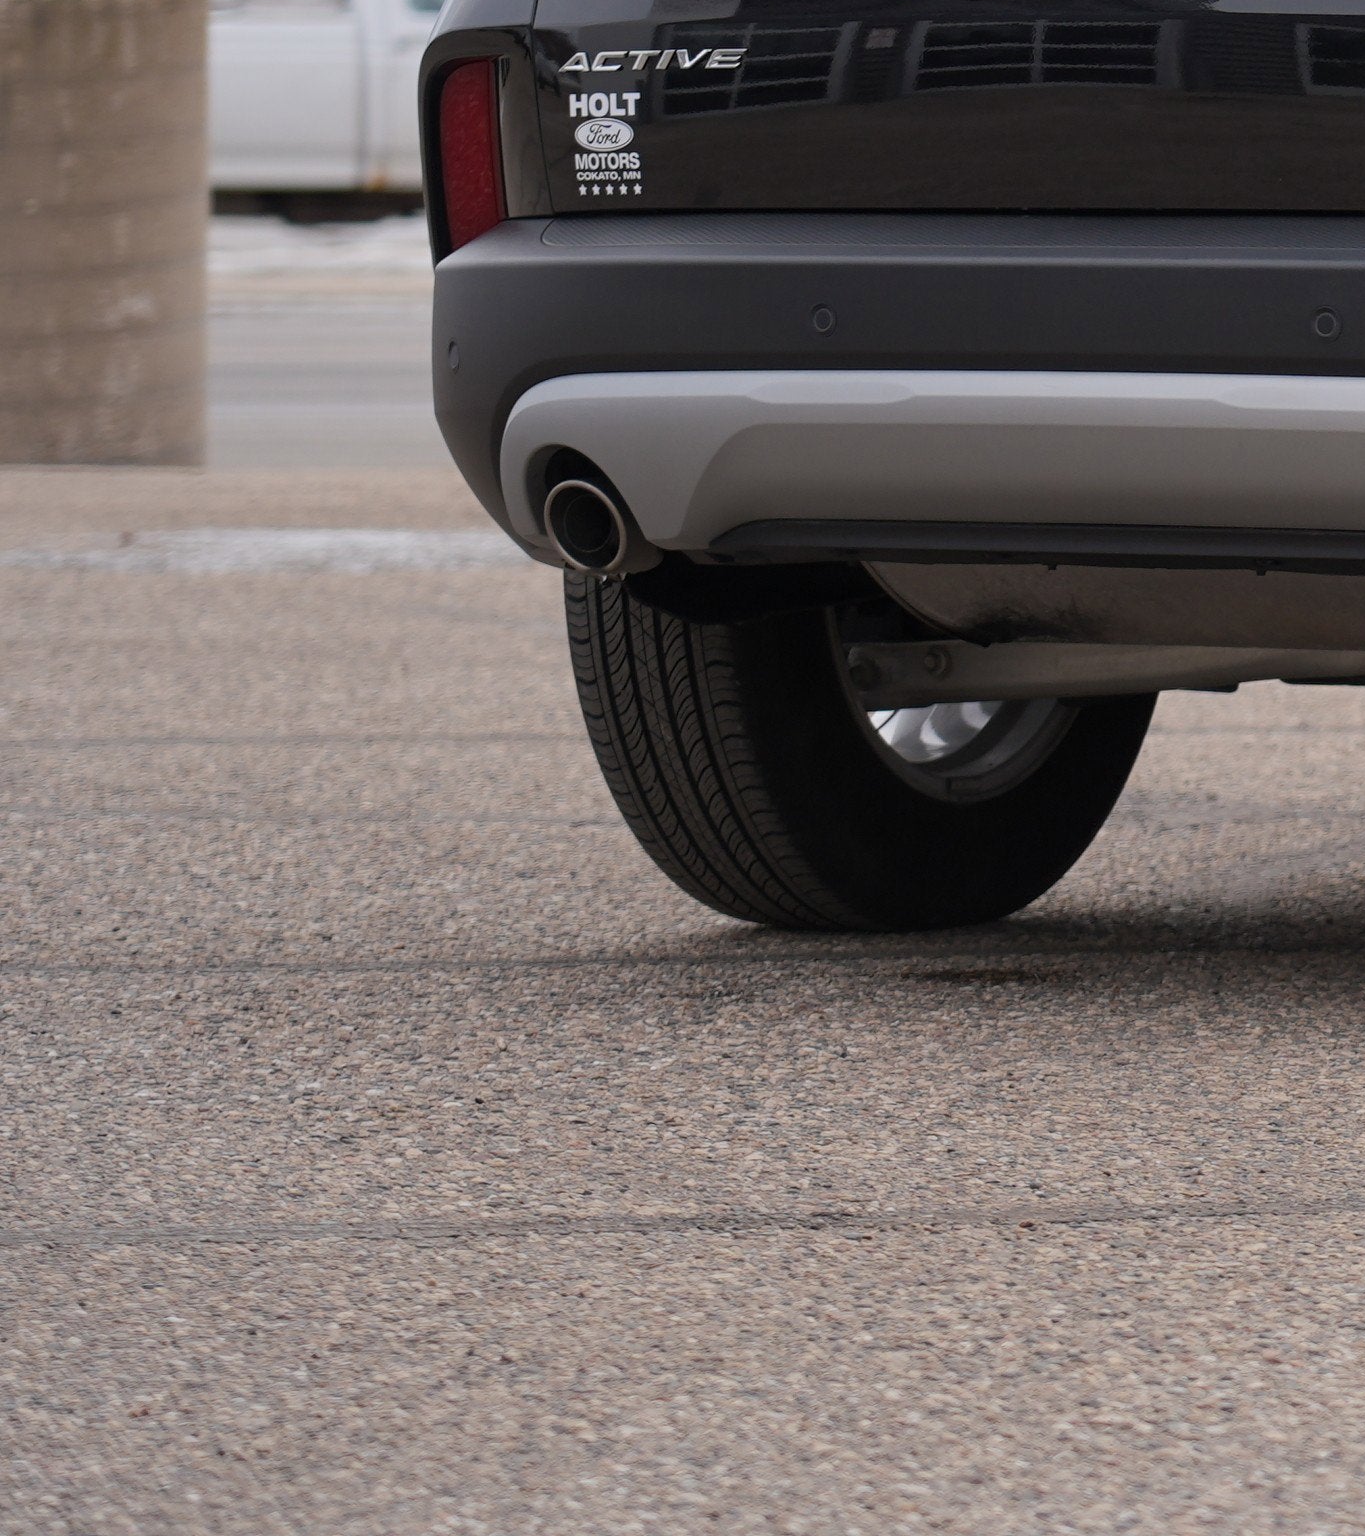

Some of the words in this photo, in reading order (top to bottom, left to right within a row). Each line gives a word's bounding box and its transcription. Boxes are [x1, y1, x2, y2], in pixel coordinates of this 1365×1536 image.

[557, 48, 749, 73] ACTIVE
[568, 92, 641, 118] HOLT
[586, 123, 622, 145] Ford
[574, 152, 641, 170] MOTORS
[576, 170, 622, 182] COKATO,
[622, 170, 642, 180] MN
